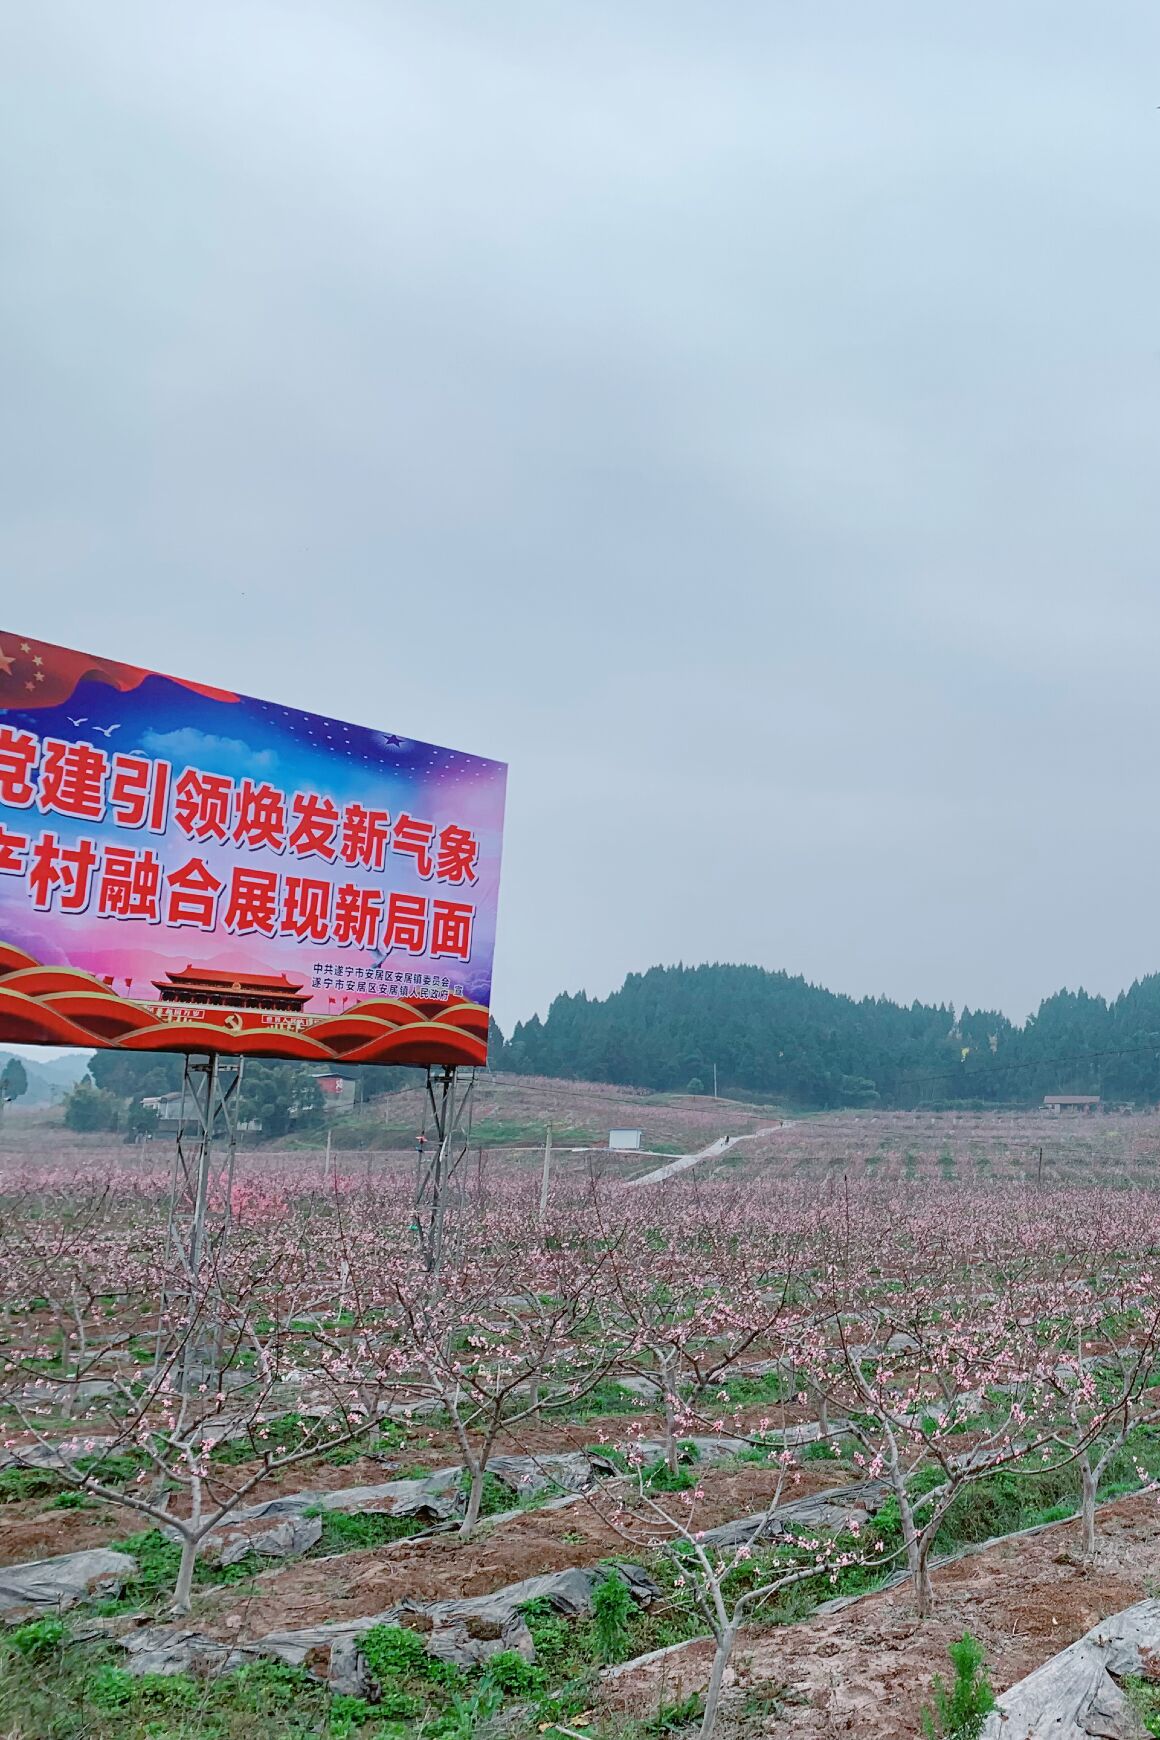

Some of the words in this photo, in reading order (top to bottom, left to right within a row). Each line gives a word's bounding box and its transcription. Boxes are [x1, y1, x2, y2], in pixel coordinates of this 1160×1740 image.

[0, 728, 478, 885] 党建引领焕发新气象
[313, 963, 450, 988] 中共遂宁市安居区安居镇委员会
[312, 977, 448, 1001] 遂宁市安居区安居镇人民政府
